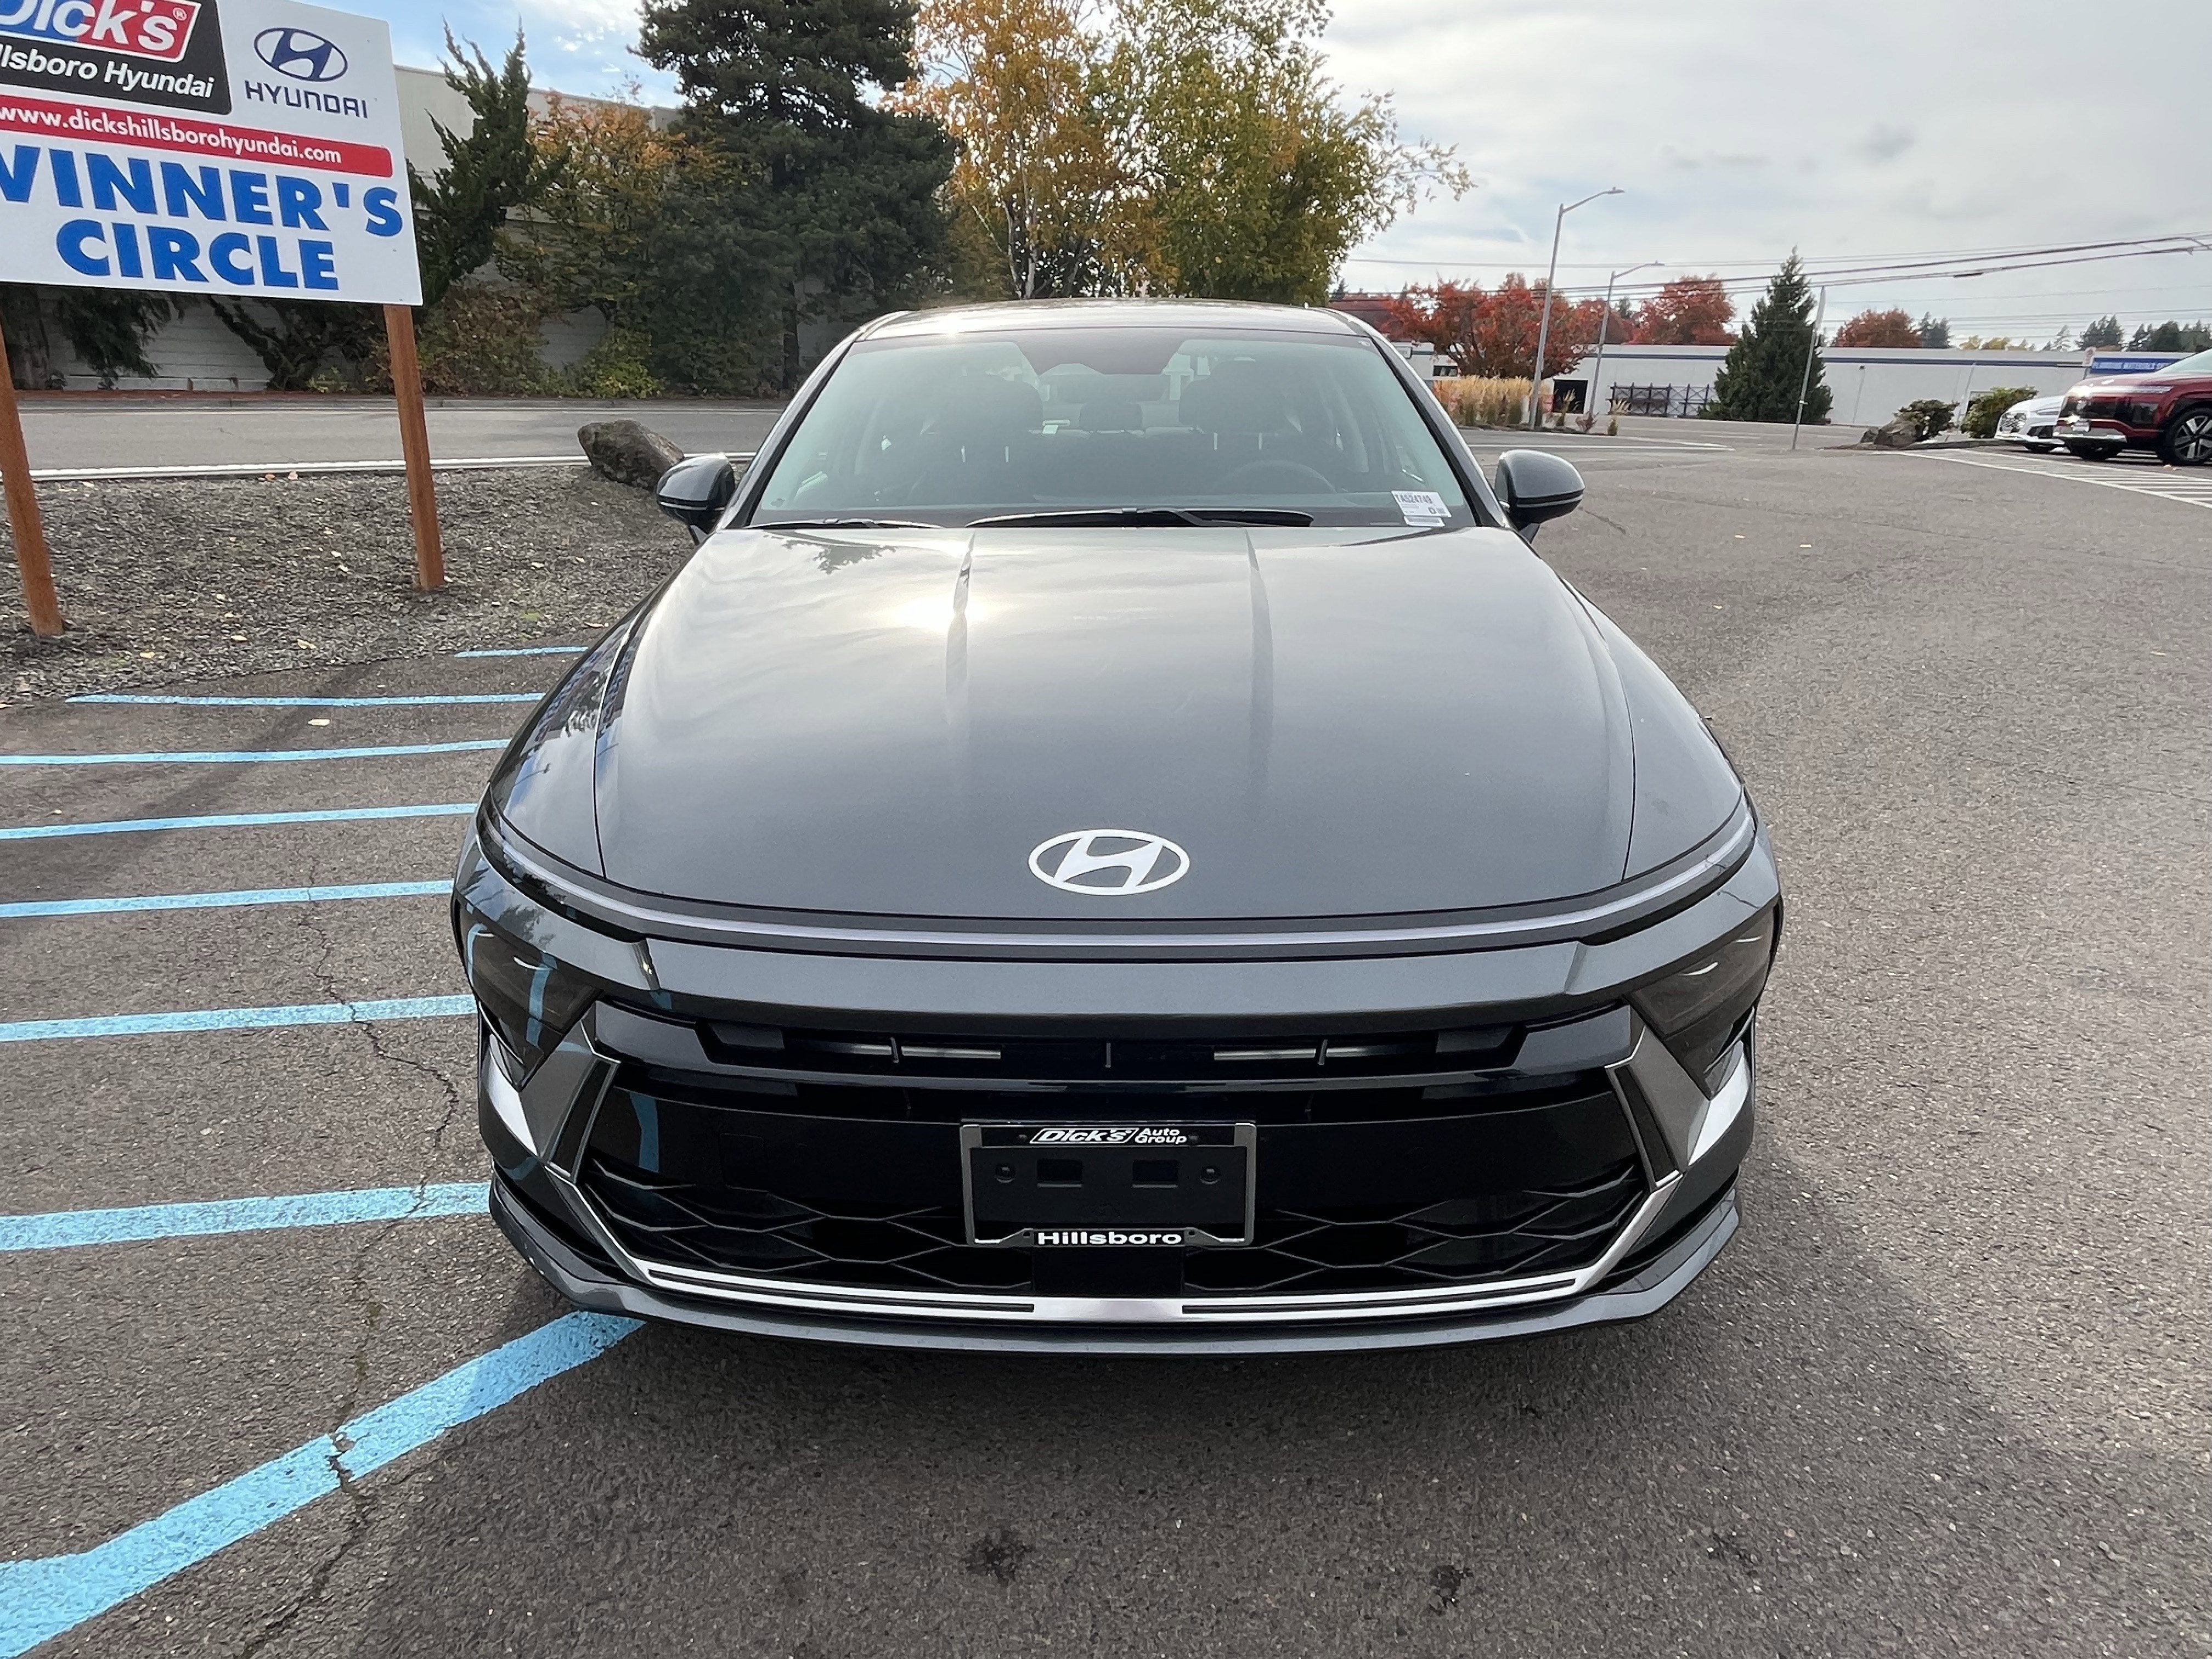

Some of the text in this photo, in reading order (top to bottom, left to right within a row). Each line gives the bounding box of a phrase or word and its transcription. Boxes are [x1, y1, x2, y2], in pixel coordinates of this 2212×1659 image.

[0, 43, 215, 98] lsboro Hyundai
[245, 80, 368, 119] HYUNDAI
[0, 106, 342, 163] www.dickshillsborohyundai.com
[56, 219, 338, 290] CIRCLE
[1038, 1128, 1127, 1141] Dick's
[1135, 1135, 1187, 1144] Group
[1140, 1128, 1180, 1136] Auto
[1038, 1231, 1182, 1244] Hillsboro
